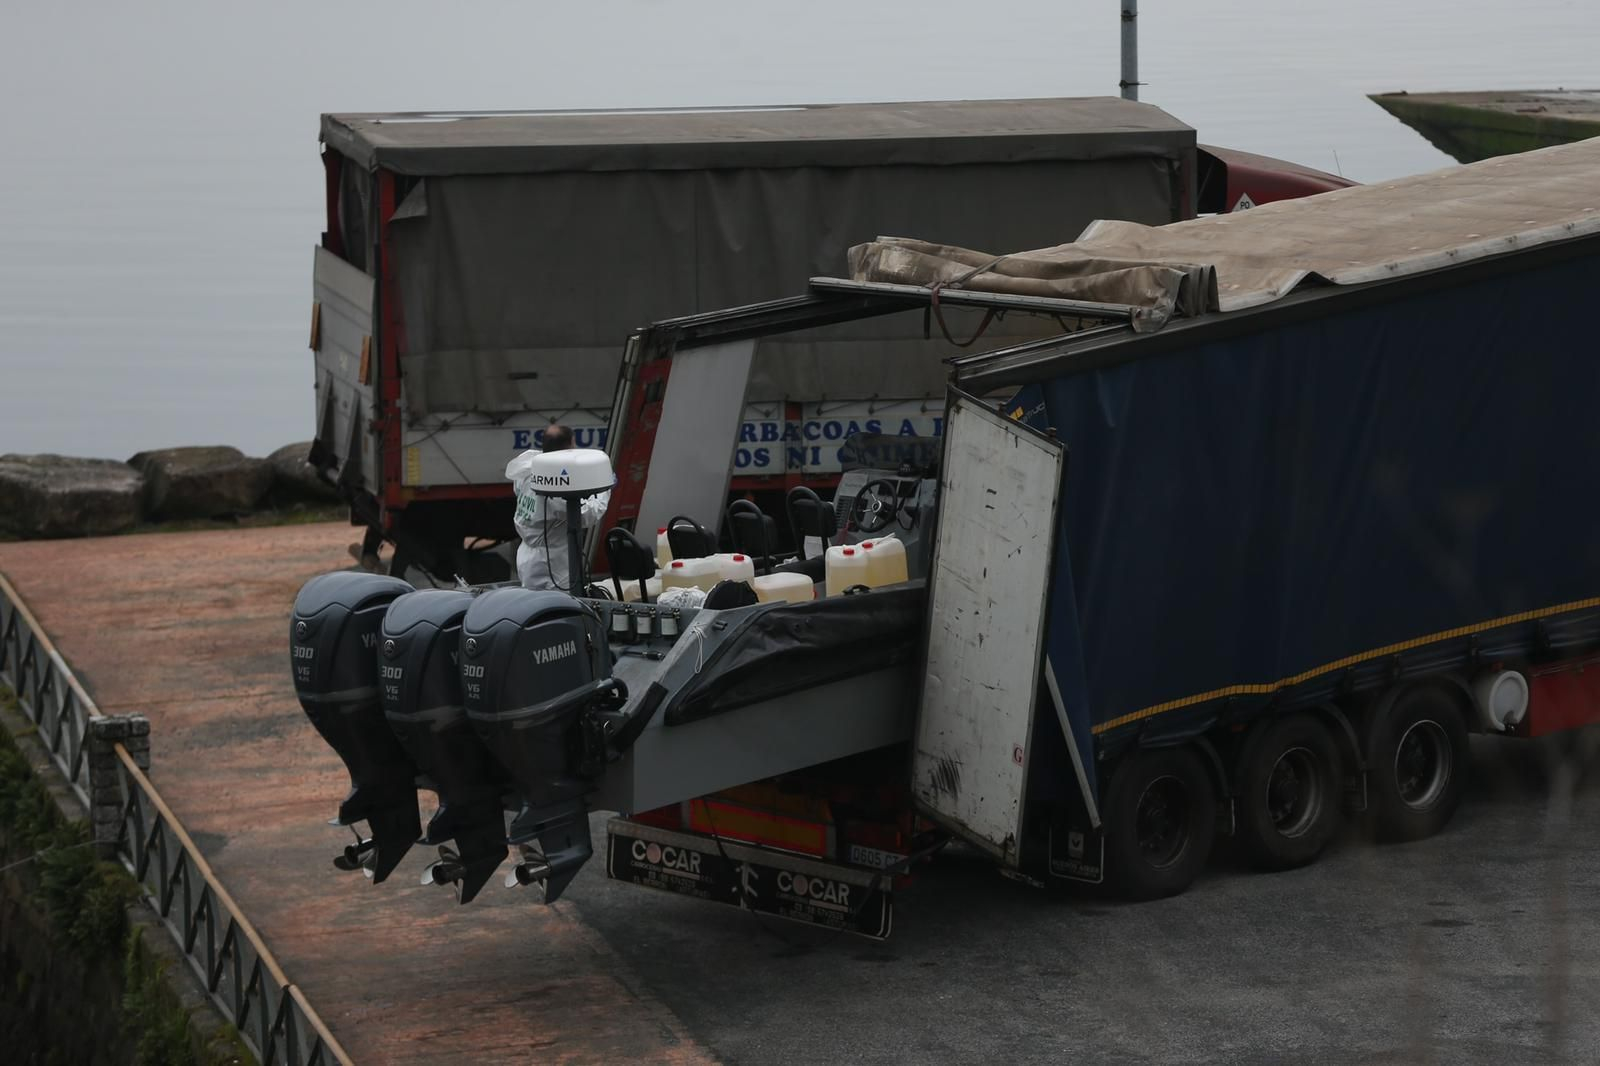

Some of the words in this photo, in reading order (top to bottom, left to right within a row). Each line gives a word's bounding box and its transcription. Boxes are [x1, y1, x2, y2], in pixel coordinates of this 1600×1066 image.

[787, 446, 821, 469] NI
[530, 472, 570, 486] ARMIN
[293, 645, 314, 659] 300
[532, 639, 577, 665] YAMAHA
[297, 666, 311, 677] V6
[381, 665, 404, 680] 300
[463, 664, 485, 678] 300
[385, 684, 400, 695] V6
[467, 683, 481, 693] V6
[1013, 746, 1023, 763] G
[631, 839, 702, 874] COCAR
[776, 870, 850, 906] COCAR
